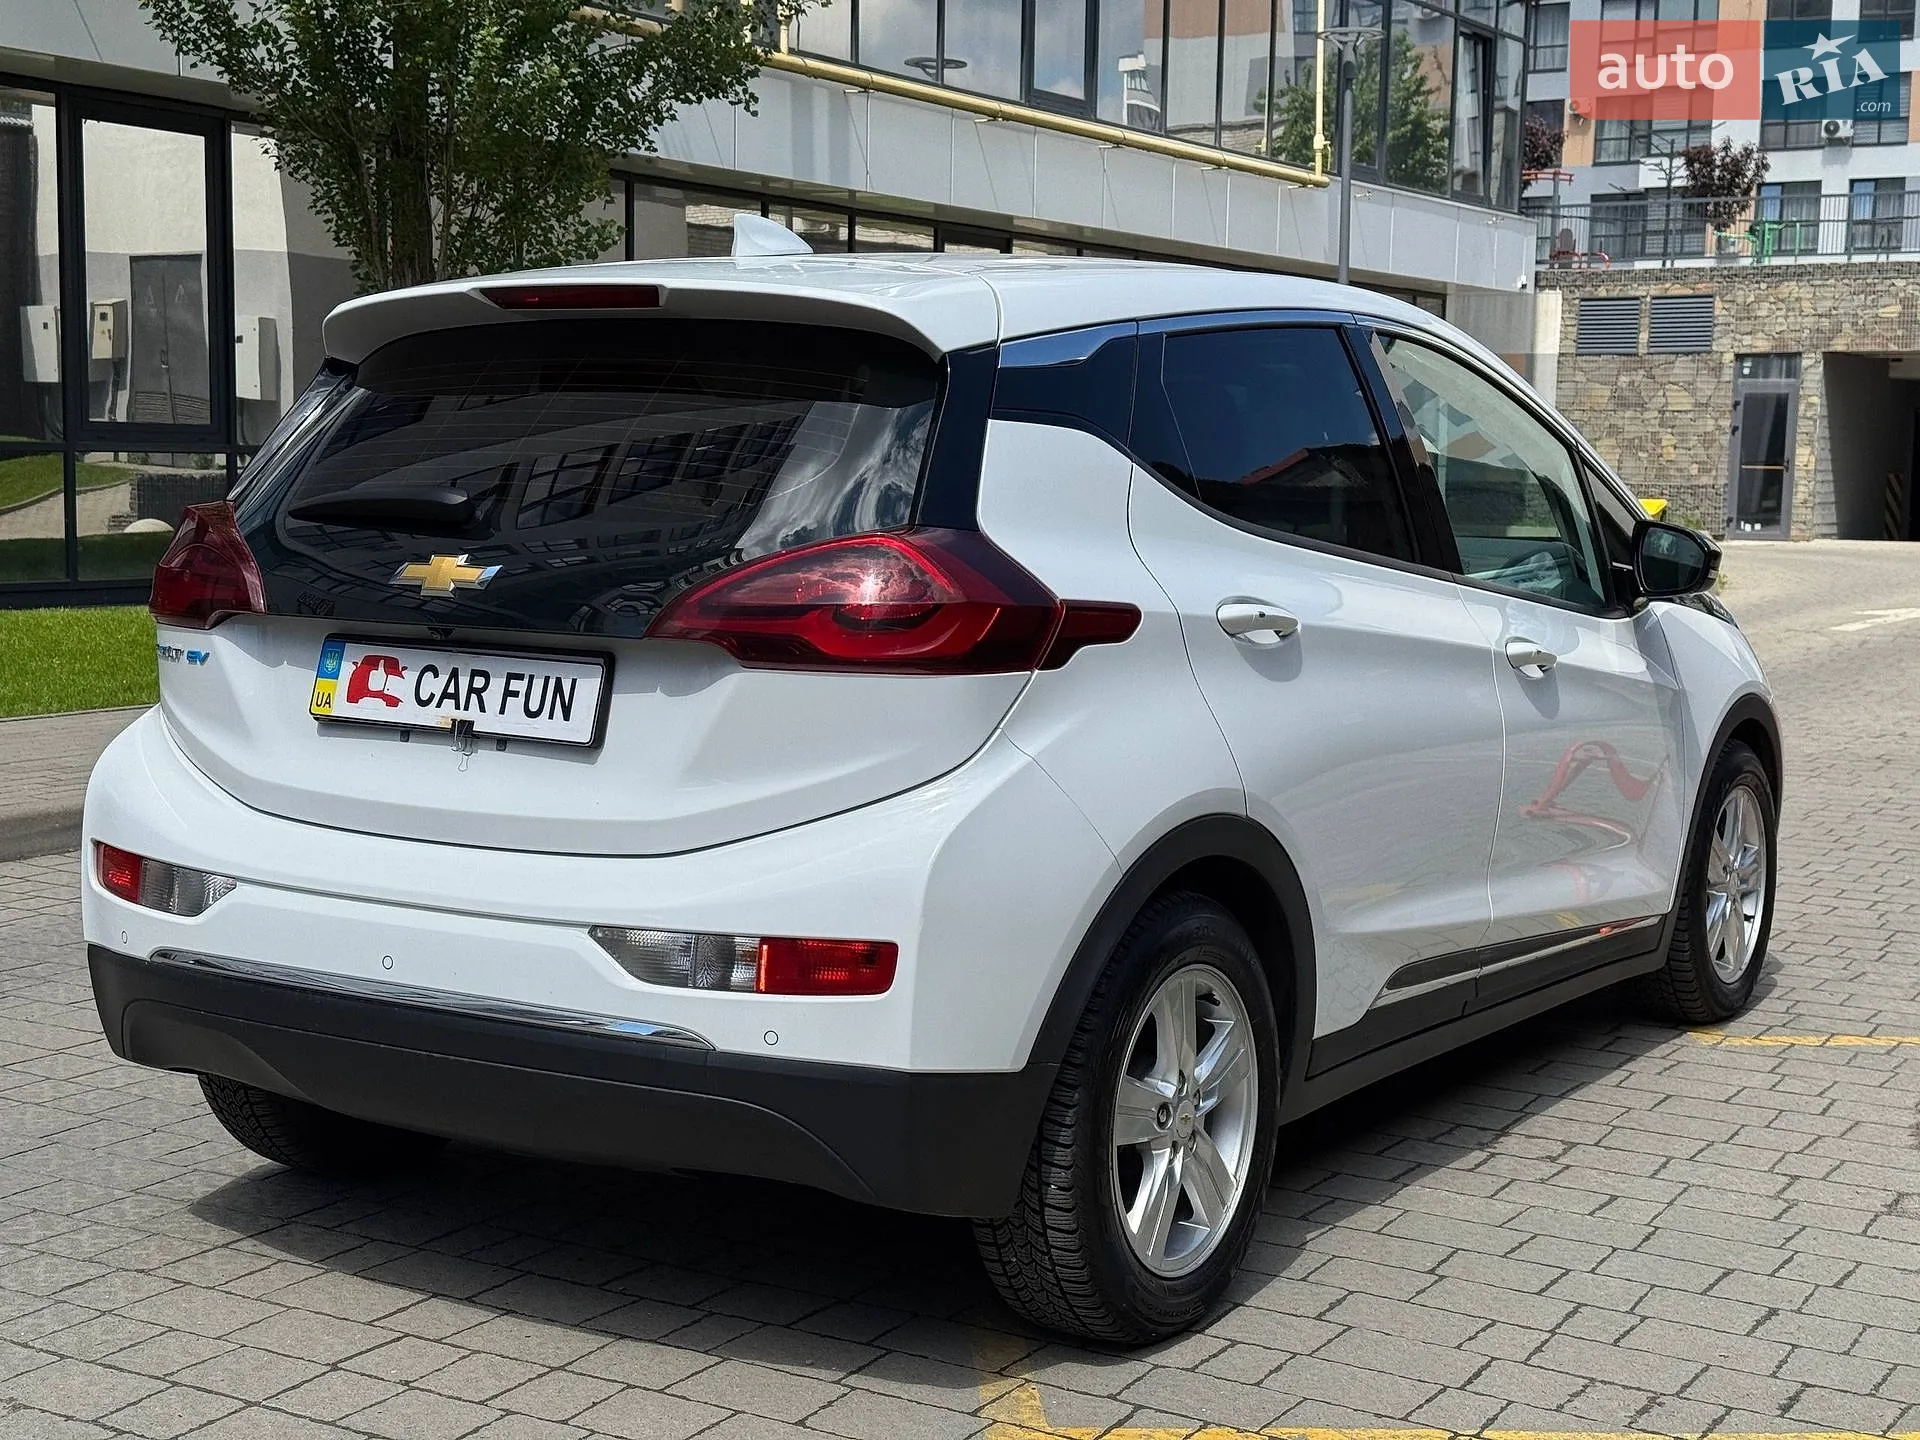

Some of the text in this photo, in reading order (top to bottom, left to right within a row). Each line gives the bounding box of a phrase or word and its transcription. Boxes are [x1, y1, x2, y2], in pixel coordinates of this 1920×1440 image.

[315, 691, 332, 709] UA
[414, 664, 578, 722] CAR FUN
